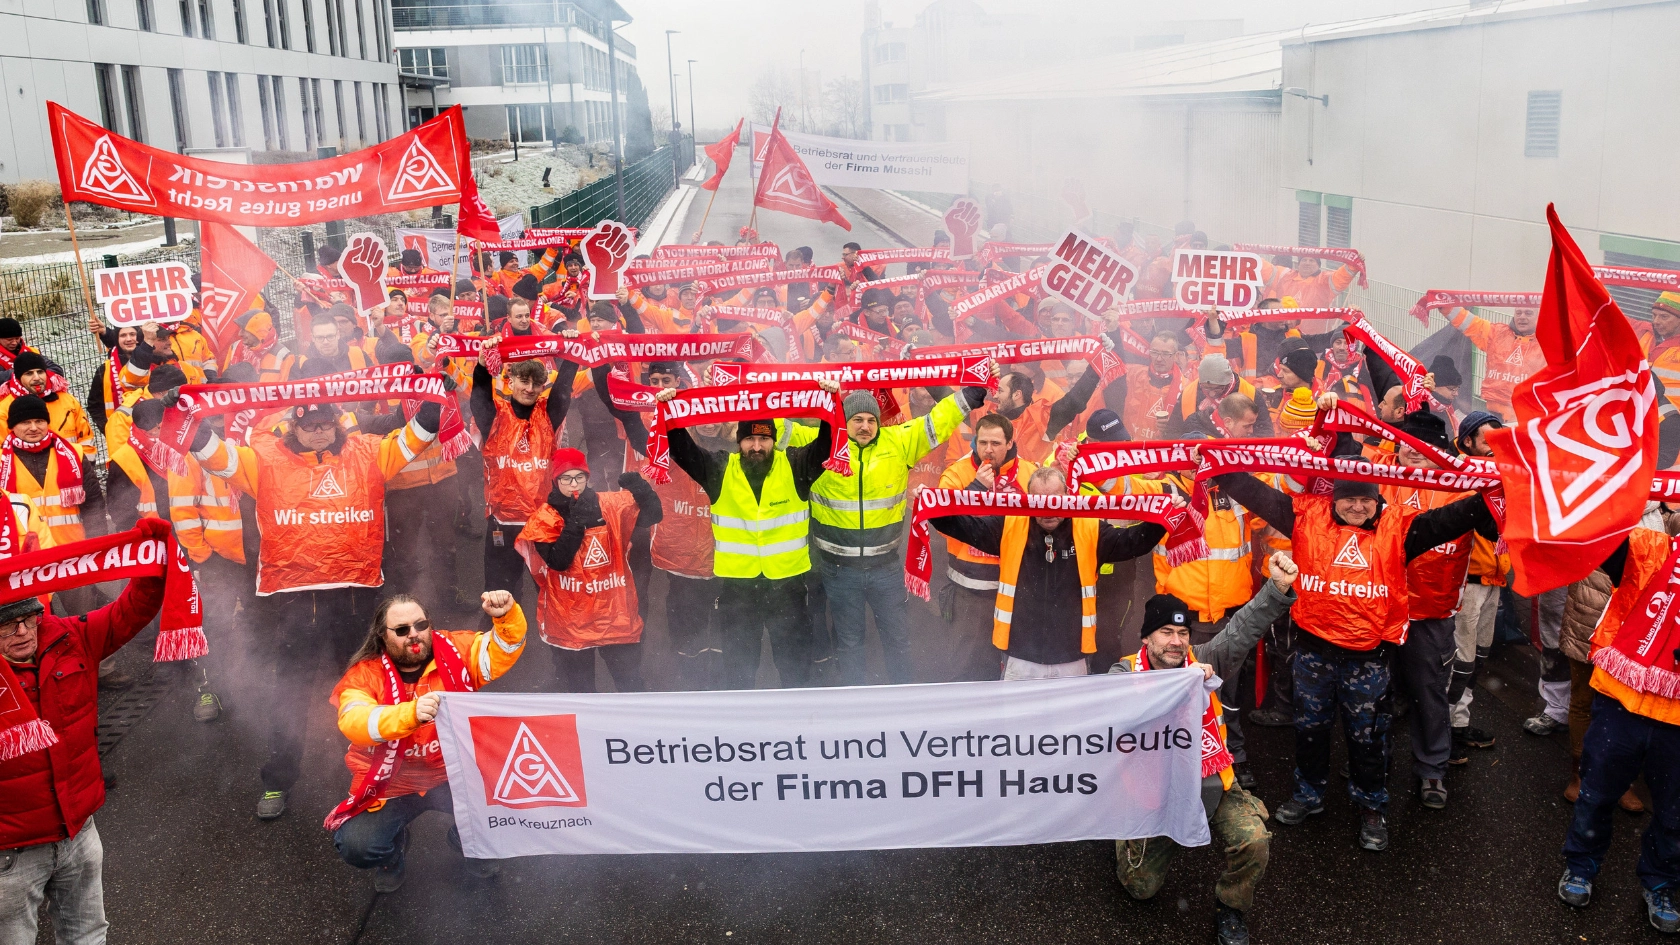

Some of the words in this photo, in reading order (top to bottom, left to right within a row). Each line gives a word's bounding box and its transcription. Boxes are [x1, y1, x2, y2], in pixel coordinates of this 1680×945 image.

[793, 144, 853, 160] Betriebsrat
[856, 153, 877, 162] und
[881, 154, 966, 166] Vertrauensleute
[825, 161, 842, 171] der
[846, 163, 879, 173] Firma
[883, 165, 932, 176] Musashi
[513, 239, 537, 248] WORK
[537, 236, 564, 246] ALONE!
[665, 248, 685, 257] YOU
[686, 248, 718, 257] NEVER
[720, 247, 750, 257] WORK
[1292, 246, 1322, 255] WORK
[633, 272, 656, 284] YOU
[658, 268, 694, 281] NEVER
[697, 263, 729, 276] WORK
[1055, 231, 1134, 296] MEHR
[1177, 254, 1258, 281] MEHR
[101, 266, 189, 298] MEHR
[710, 277, 735, 289] YOU
[737, 272, 774, 285] NEVER
[776, 268, 811, 281] WORK
[1046, 263, 1114, 317] GELD
[1180, 281, 1252, 306] GELD
[1455, 294, 1481, 304] YOU
[1483, 294, 1526, 305] NEVER
[111, 296, 188, 323] GELD
[718, 305, 754, 317] NEVER
[462, 339, 482, 352] YO
[629, 342, 678, 357] WORK
[680, 341, 735, 356] ALONE!
[1019, 338, 1100, 356] GEWINNT!
[867, 365, 958, 382] GEWINNT!
[199, 388, 246, 408] YOU
[249, 382, 319, 402] NEVER
[325, 378, 387, 398] WORK
[664, 390, 762, 421] LIDARITÄT
[1208, 449, 1254, 466] YOU
[1254, 451, 1329, 472] NEVER
[1334, 458, 1407, 480] WORK
[674, 500, 692, 514] Wir
[918, 488, 951, 511] YOU
[954, 489, 1022, 508] NEVER
[1027, 494, 1087, 511] WORK
[1093, 496, 1171, 514] ALONE!
[274, 508, 305, 525] Wir
[309, 506, 374, 526] streiken
[8, 551, 102, 590] WORK
[103, 539, 167, 570] ALON
[559, 574, 582, 593] Wir
[585, 573, 626, 594] streike
[1300, 573, 1326, 592] Wir
[606, 732, 806, 765] Betriebsrat
[820, 731, 887, 759] und
[900, 723, 1193, 759] Vertrauensleute
[705, 775, 763, 802] der
[777, 772, 887, 801] Firma
[901, 769, 984, 799] DFH
[1000, 768, 1098, 797] Haus
[488, 815, 516, 829] Bad
[519, 816, 592, 830] Kreuznach
